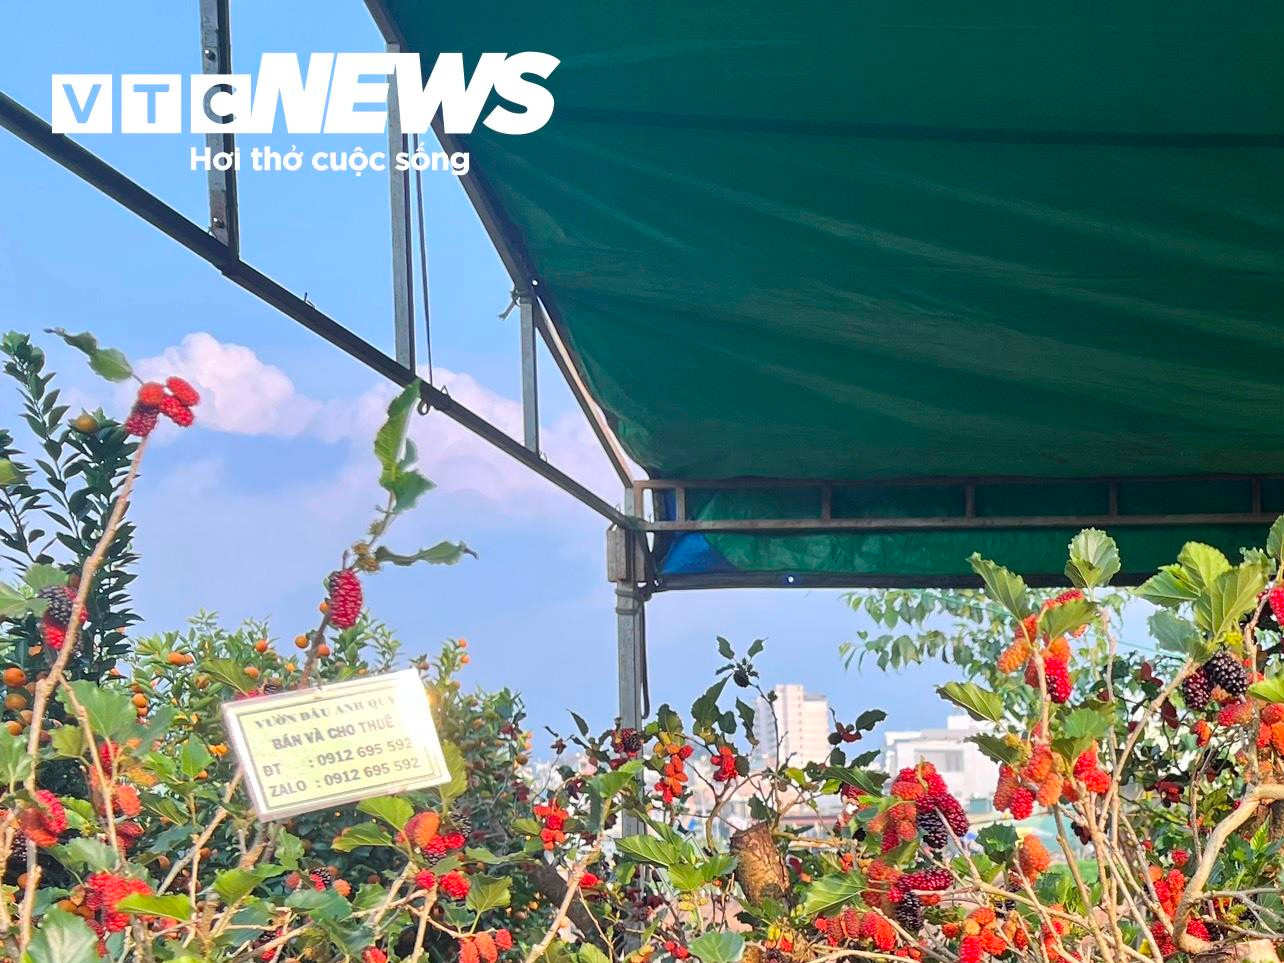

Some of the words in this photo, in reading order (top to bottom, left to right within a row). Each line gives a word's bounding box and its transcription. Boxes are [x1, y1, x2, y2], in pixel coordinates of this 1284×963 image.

[271, 733, 303, 750] BÁN
[304, 727, 325, 744] VÀ
[327, 724, 356, 740] CHO
[358, 713, 395, 734] THUÊ
[262, 763, 281, 777] ĐT
[316, 749, 354, 767] 0912
[356, 743, 384, 758] 695
[387, 737, 414, 753] 592
[268, 780, 307, 797] ZALO
[323, 769, 361, 787] 0912
[363, 763, 391, 779] 695
[394, 757, 421, 773] 592
